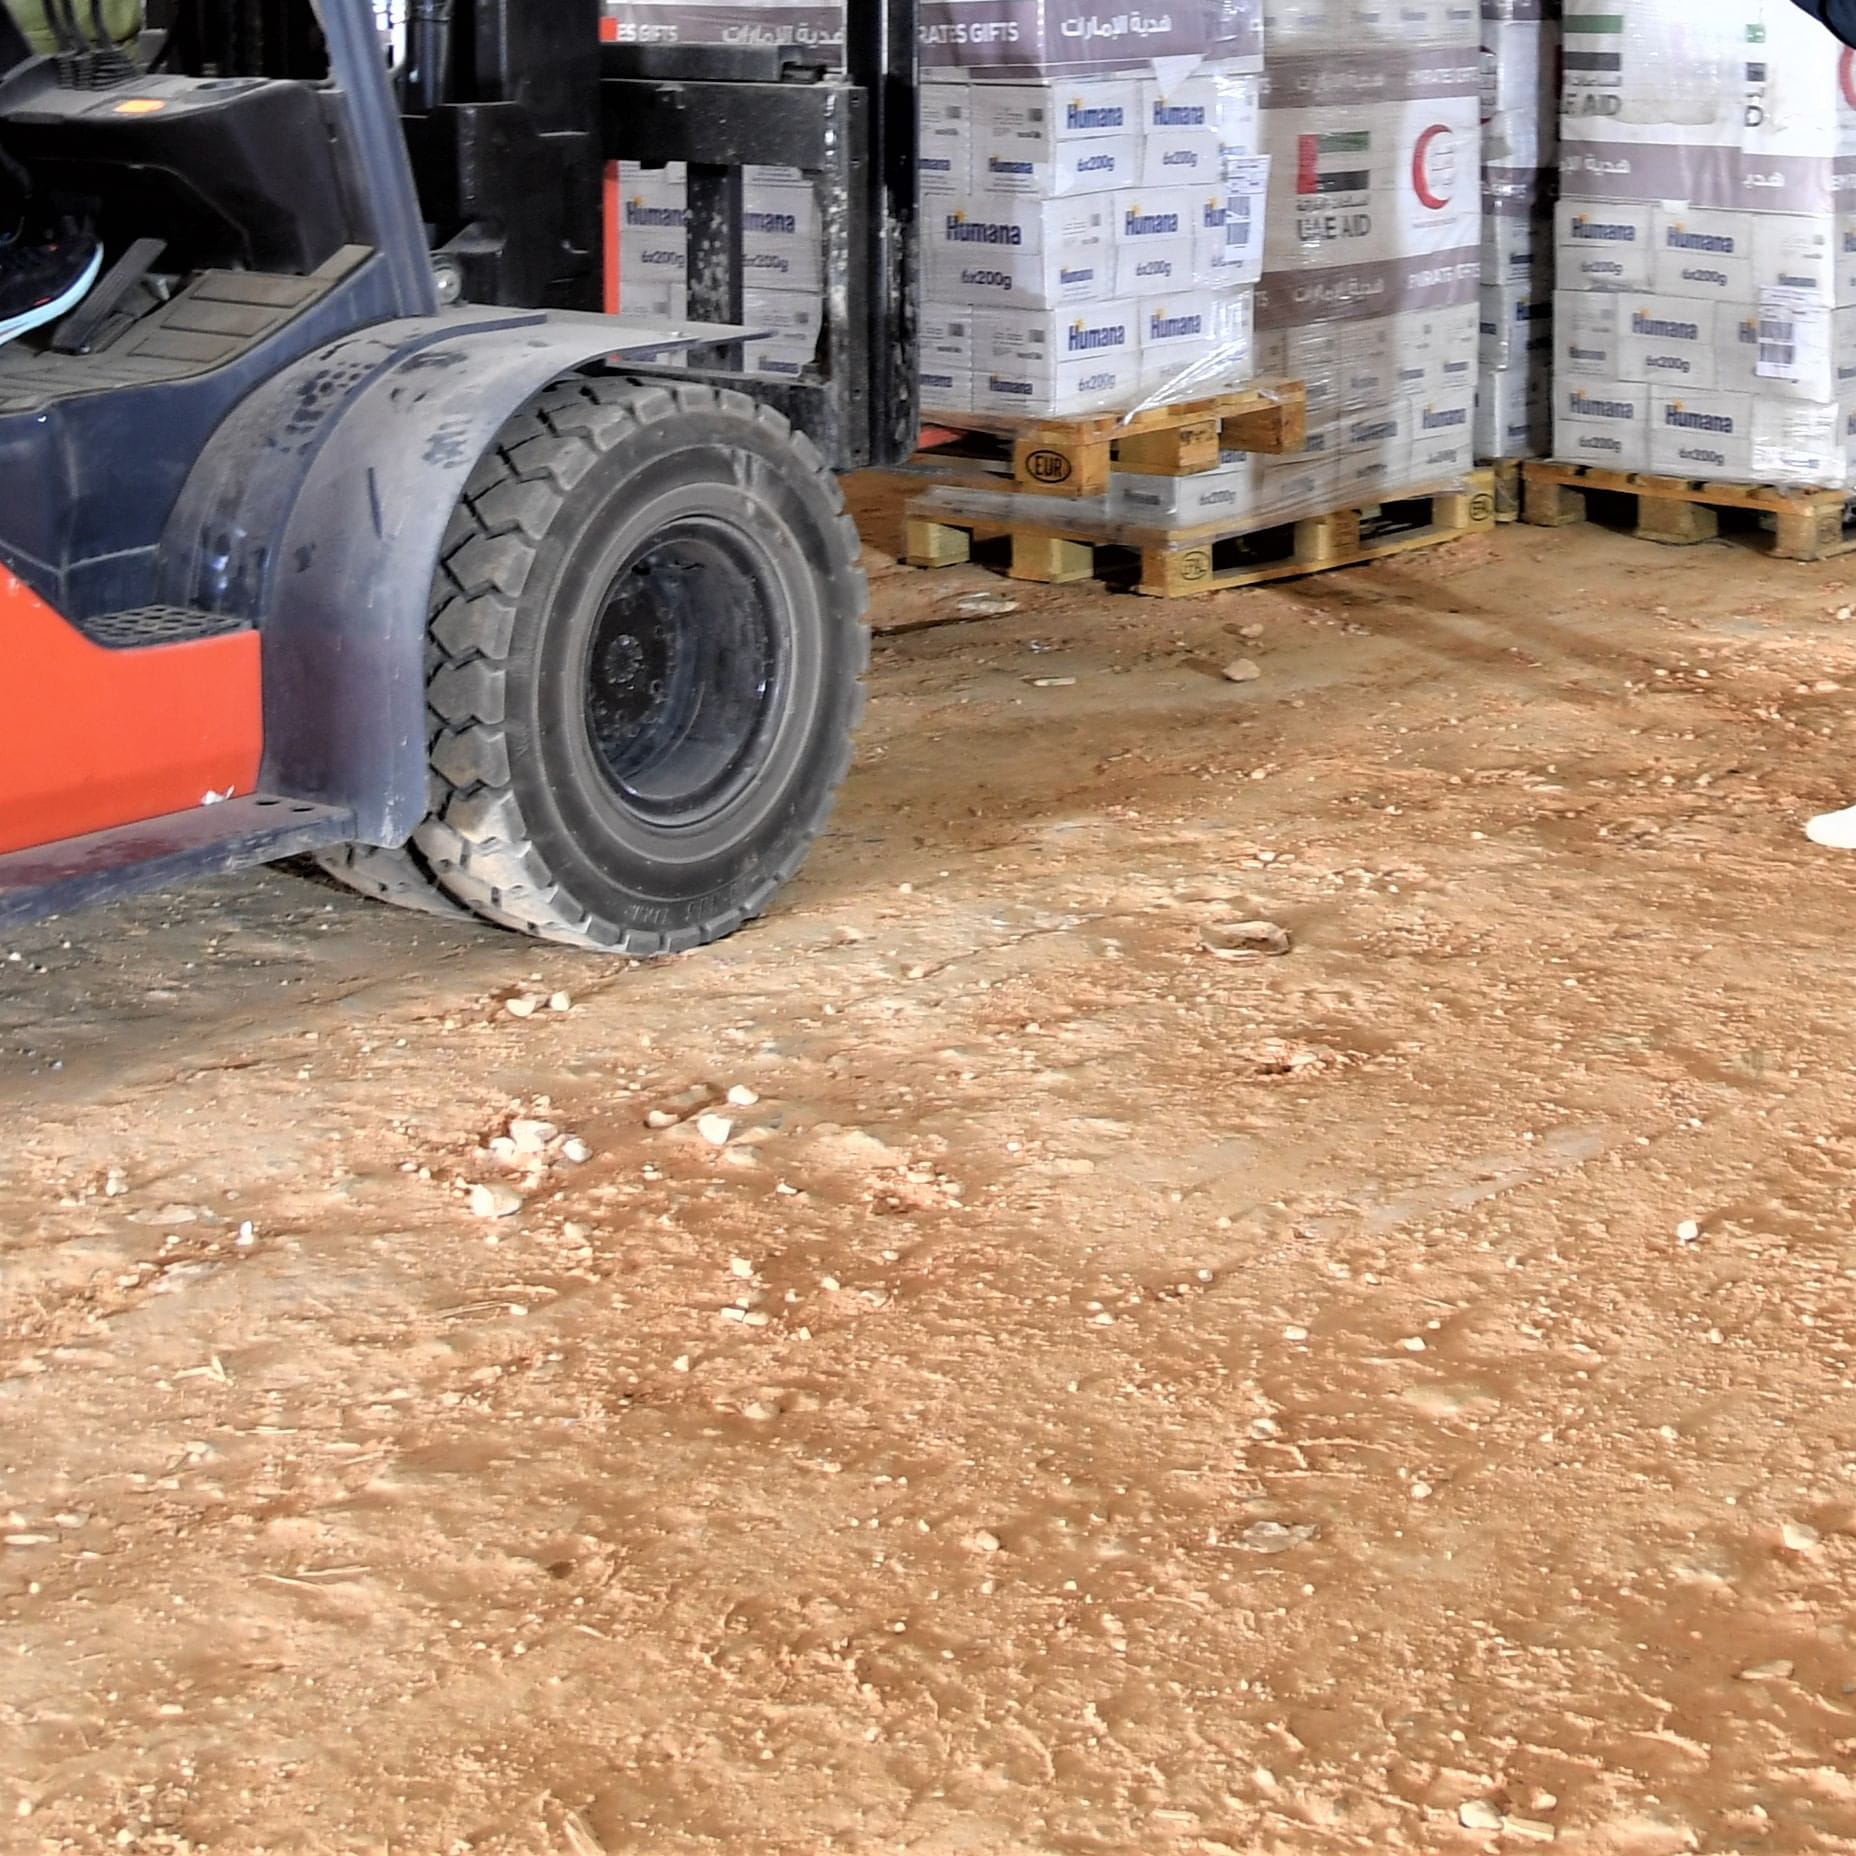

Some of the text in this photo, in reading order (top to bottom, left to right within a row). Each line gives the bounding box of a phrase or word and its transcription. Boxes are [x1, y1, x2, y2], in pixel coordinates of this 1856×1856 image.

[919, 22, 1019, 44] RATES GIFTS
[1060, 12, 1173, 40] هدية الإمارات
[1067, 97, 1124, 130] Humana
[1153, 100, 1205, 125] Humana
[1077, 155, 1115, 172] 6x200g
[946, 215, 1021, 245] Humana
[1125, 210, 1178, 236] Humana
[961, 269, 1012, 290] 6x200g
[1068, 324, 1125, 351] Humana
[1151, 313, 1201, 339] Humana
[1570, 392, 1633, 419] Humana
[1665, 404, 1733, 433] Humana
[1035, 456, 1063, 478] EUR
